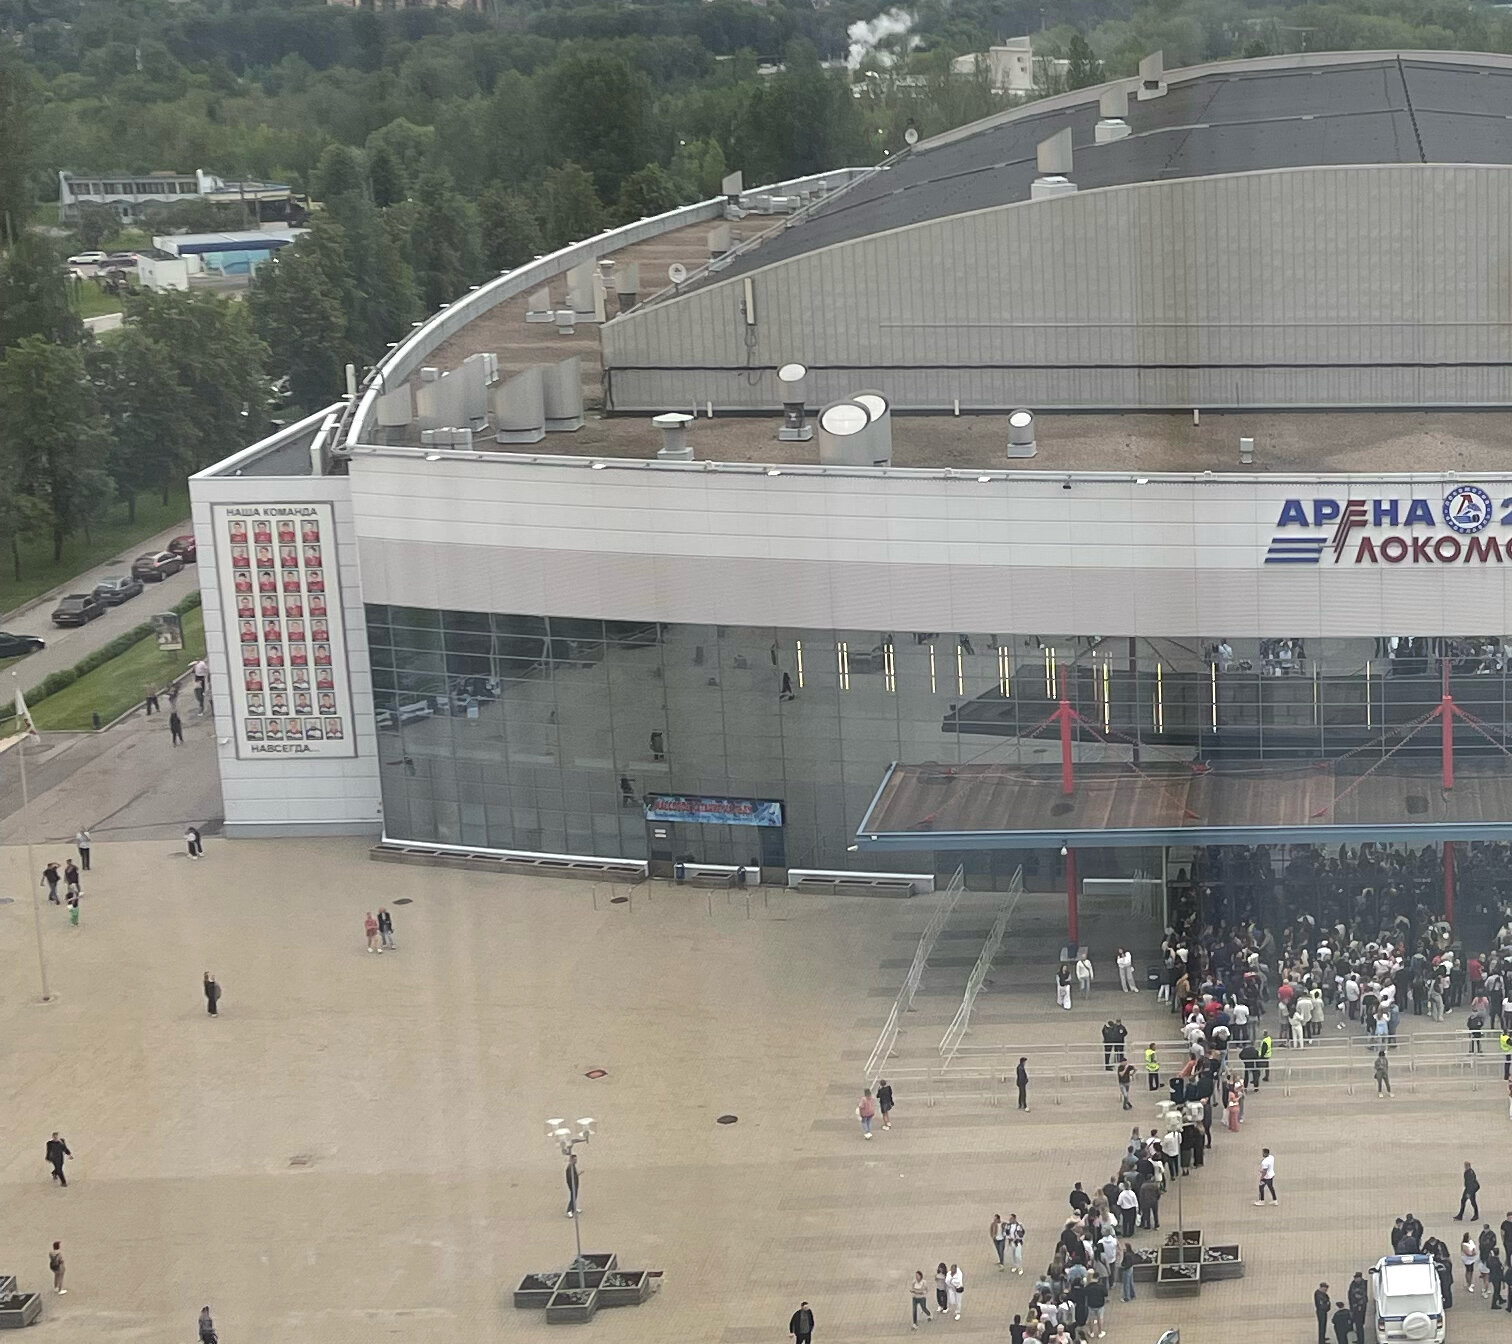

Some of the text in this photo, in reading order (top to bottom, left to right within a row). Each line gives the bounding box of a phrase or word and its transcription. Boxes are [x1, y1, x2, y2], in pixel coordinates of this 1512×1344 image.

[226, 507, 318, 517] НАША КОМАНДА
[1276, 498, 1436, 528] АРЕНА
